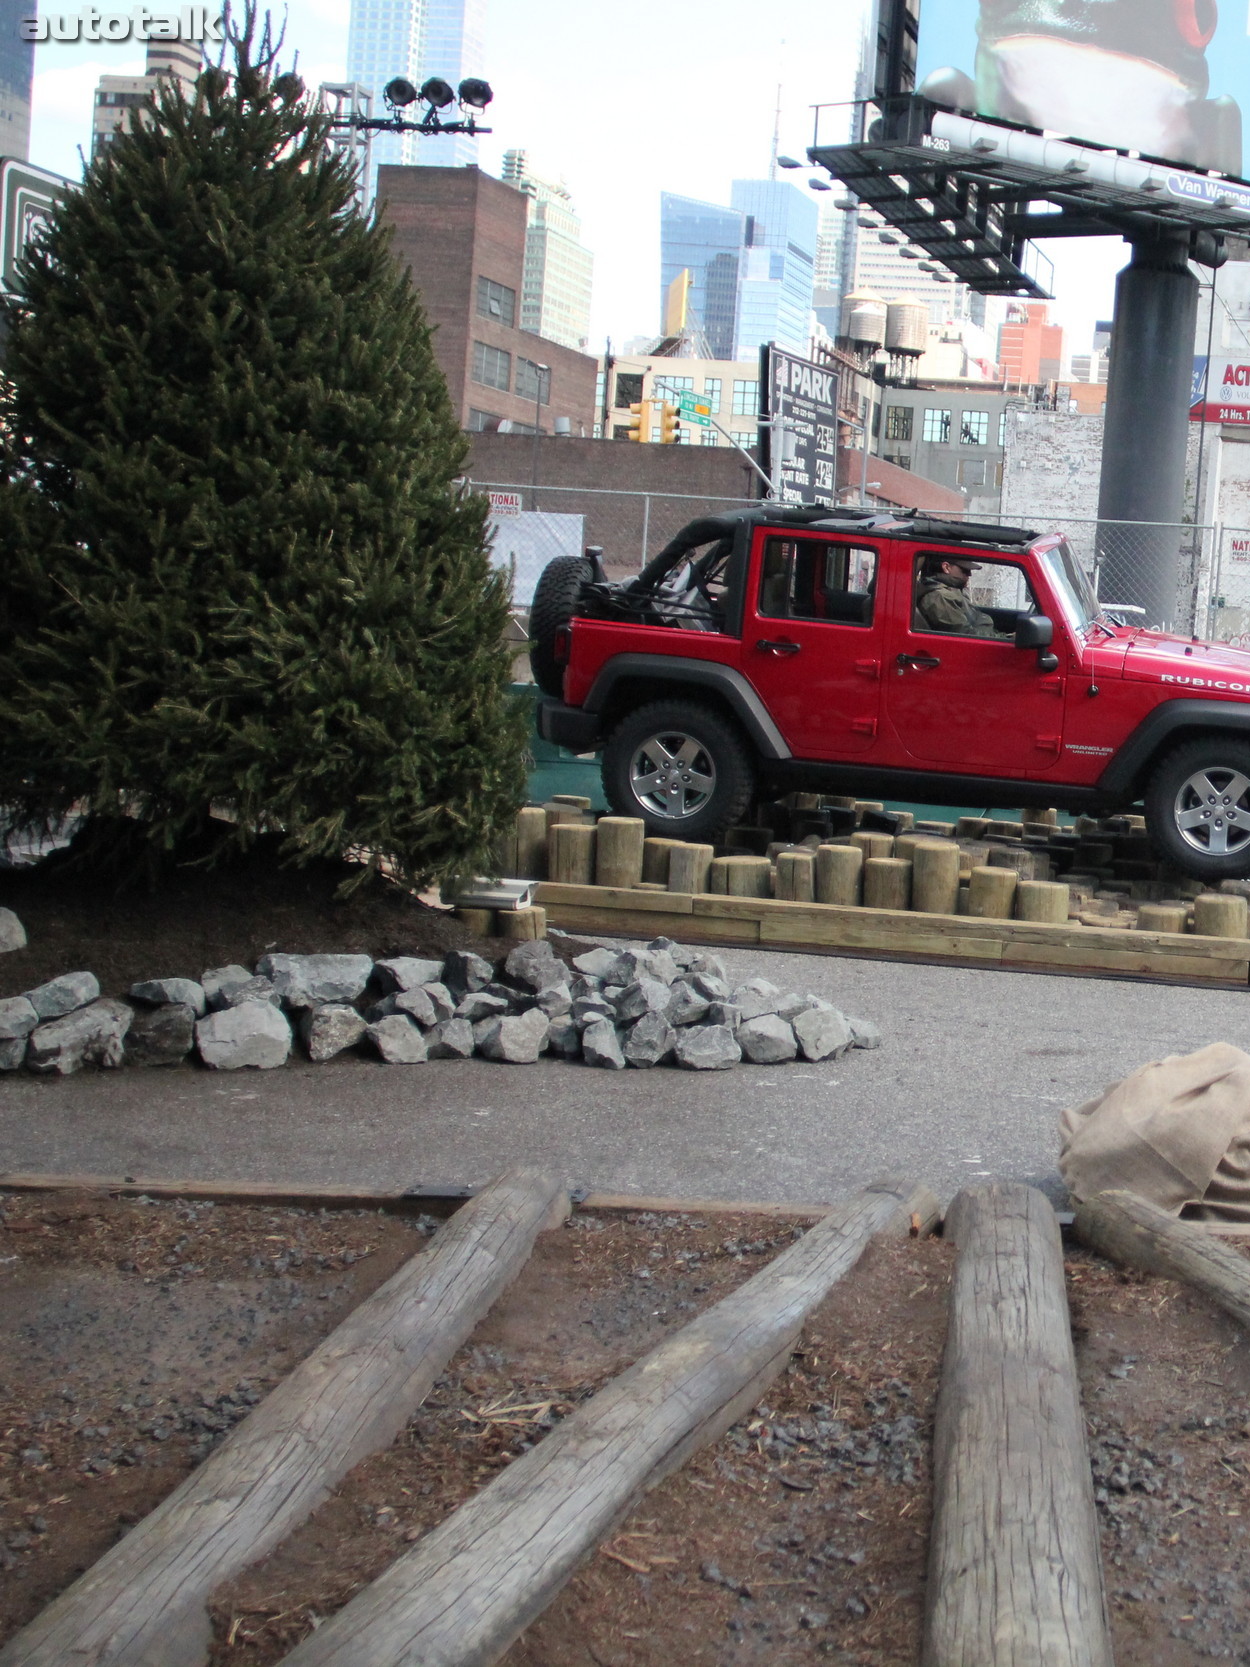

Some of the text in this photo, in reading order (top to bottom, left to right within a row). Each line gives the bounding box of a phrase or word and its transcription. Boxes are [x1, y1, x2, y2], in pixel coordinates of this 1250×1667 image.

[922, 134, 950, 151] M-263
[1178, 177, 1202, 195] Van
[791, 362, 834, 405] PARK
[1219, 409, 1228, 419] 24
[1230, 409, 1244, 420] Hrs.
[795, 471, 809, 485] RATE
[490, 493, 519, 506] TIONAL
[1065, 743, 1114, 753] WRANGLER
